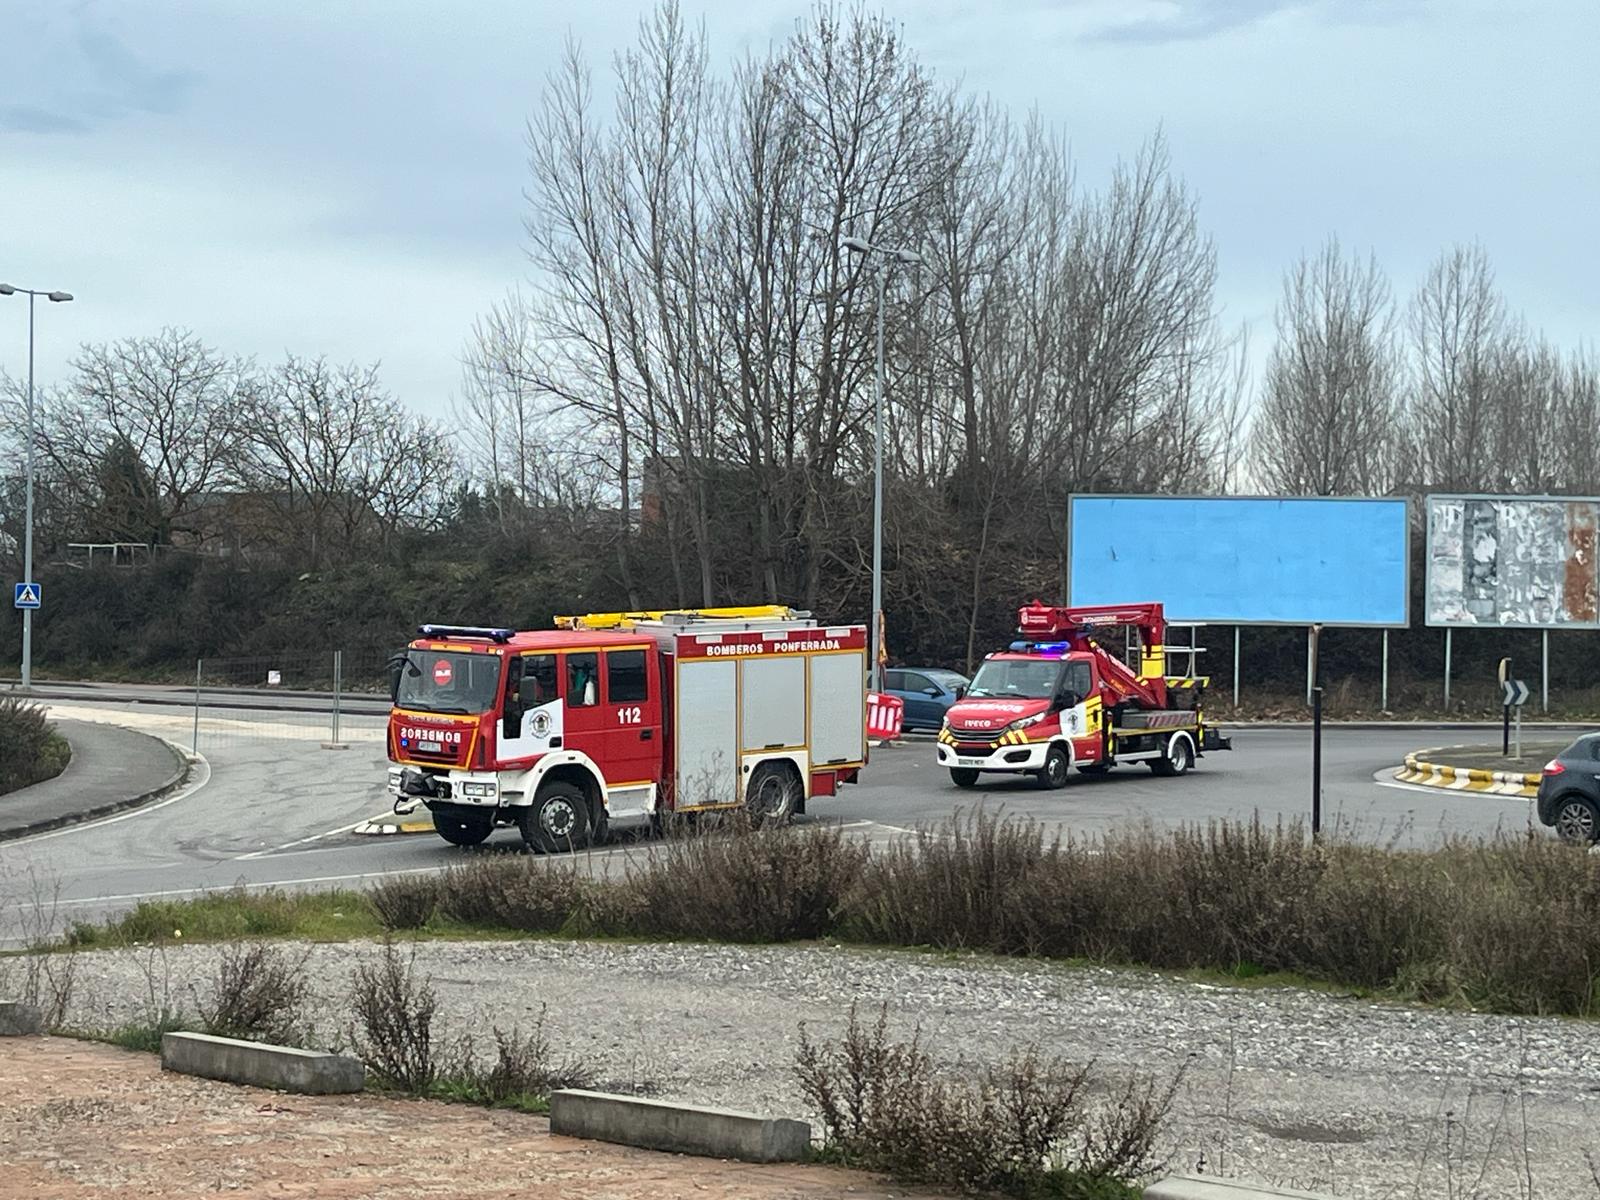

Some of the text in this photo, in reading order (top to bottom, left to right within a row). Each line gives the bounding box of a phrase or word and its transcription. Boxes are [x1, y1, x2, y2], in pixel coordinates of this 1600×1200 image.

[706, 640, 840, 656] BOMBEROS PONFERRADA
[617, 706, 641, 724] 112
[964, 719, 991, 727] IVECO
